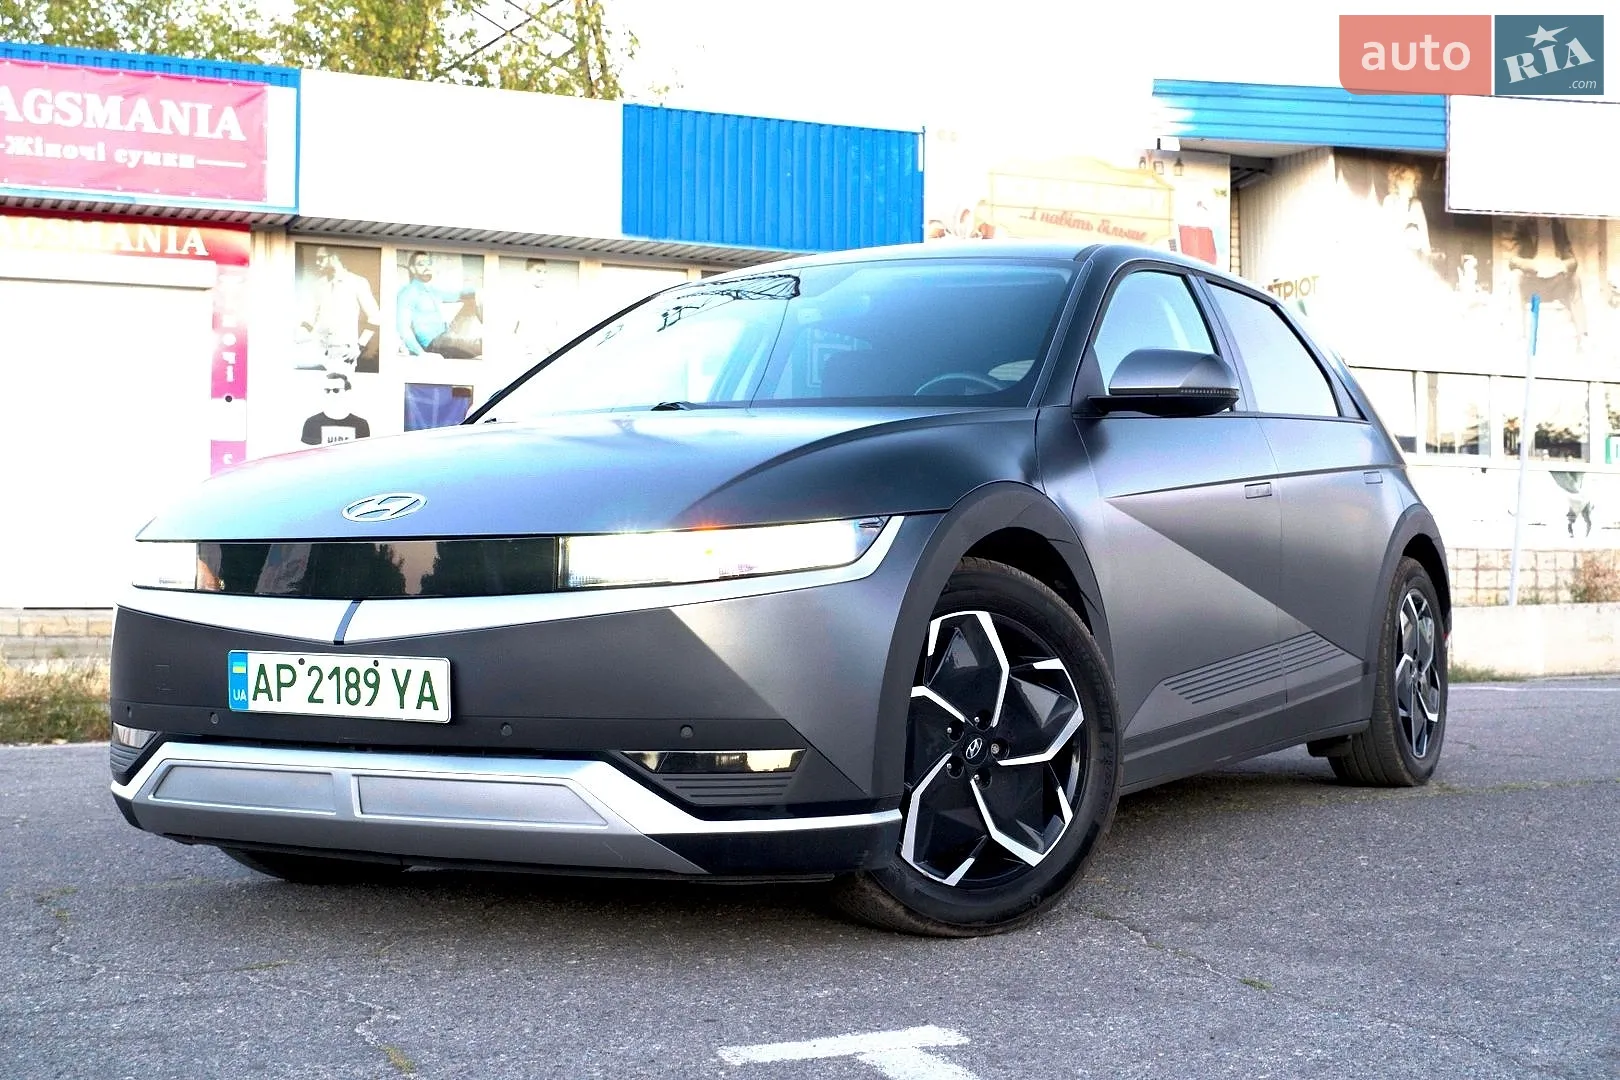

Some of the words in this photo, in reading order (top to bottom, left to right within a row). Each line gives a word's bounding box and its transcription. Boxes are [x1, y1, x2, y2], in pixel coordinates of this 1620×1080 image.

[5, 135, 105, 162] Жіночі
[114, 148, 195, 168] сумки
[233, 689, 247, 701] UA
[252, 663, 297, 702] AP
[307, 665, 381, 707] 2189
[391, 668, 439, 711] YA
